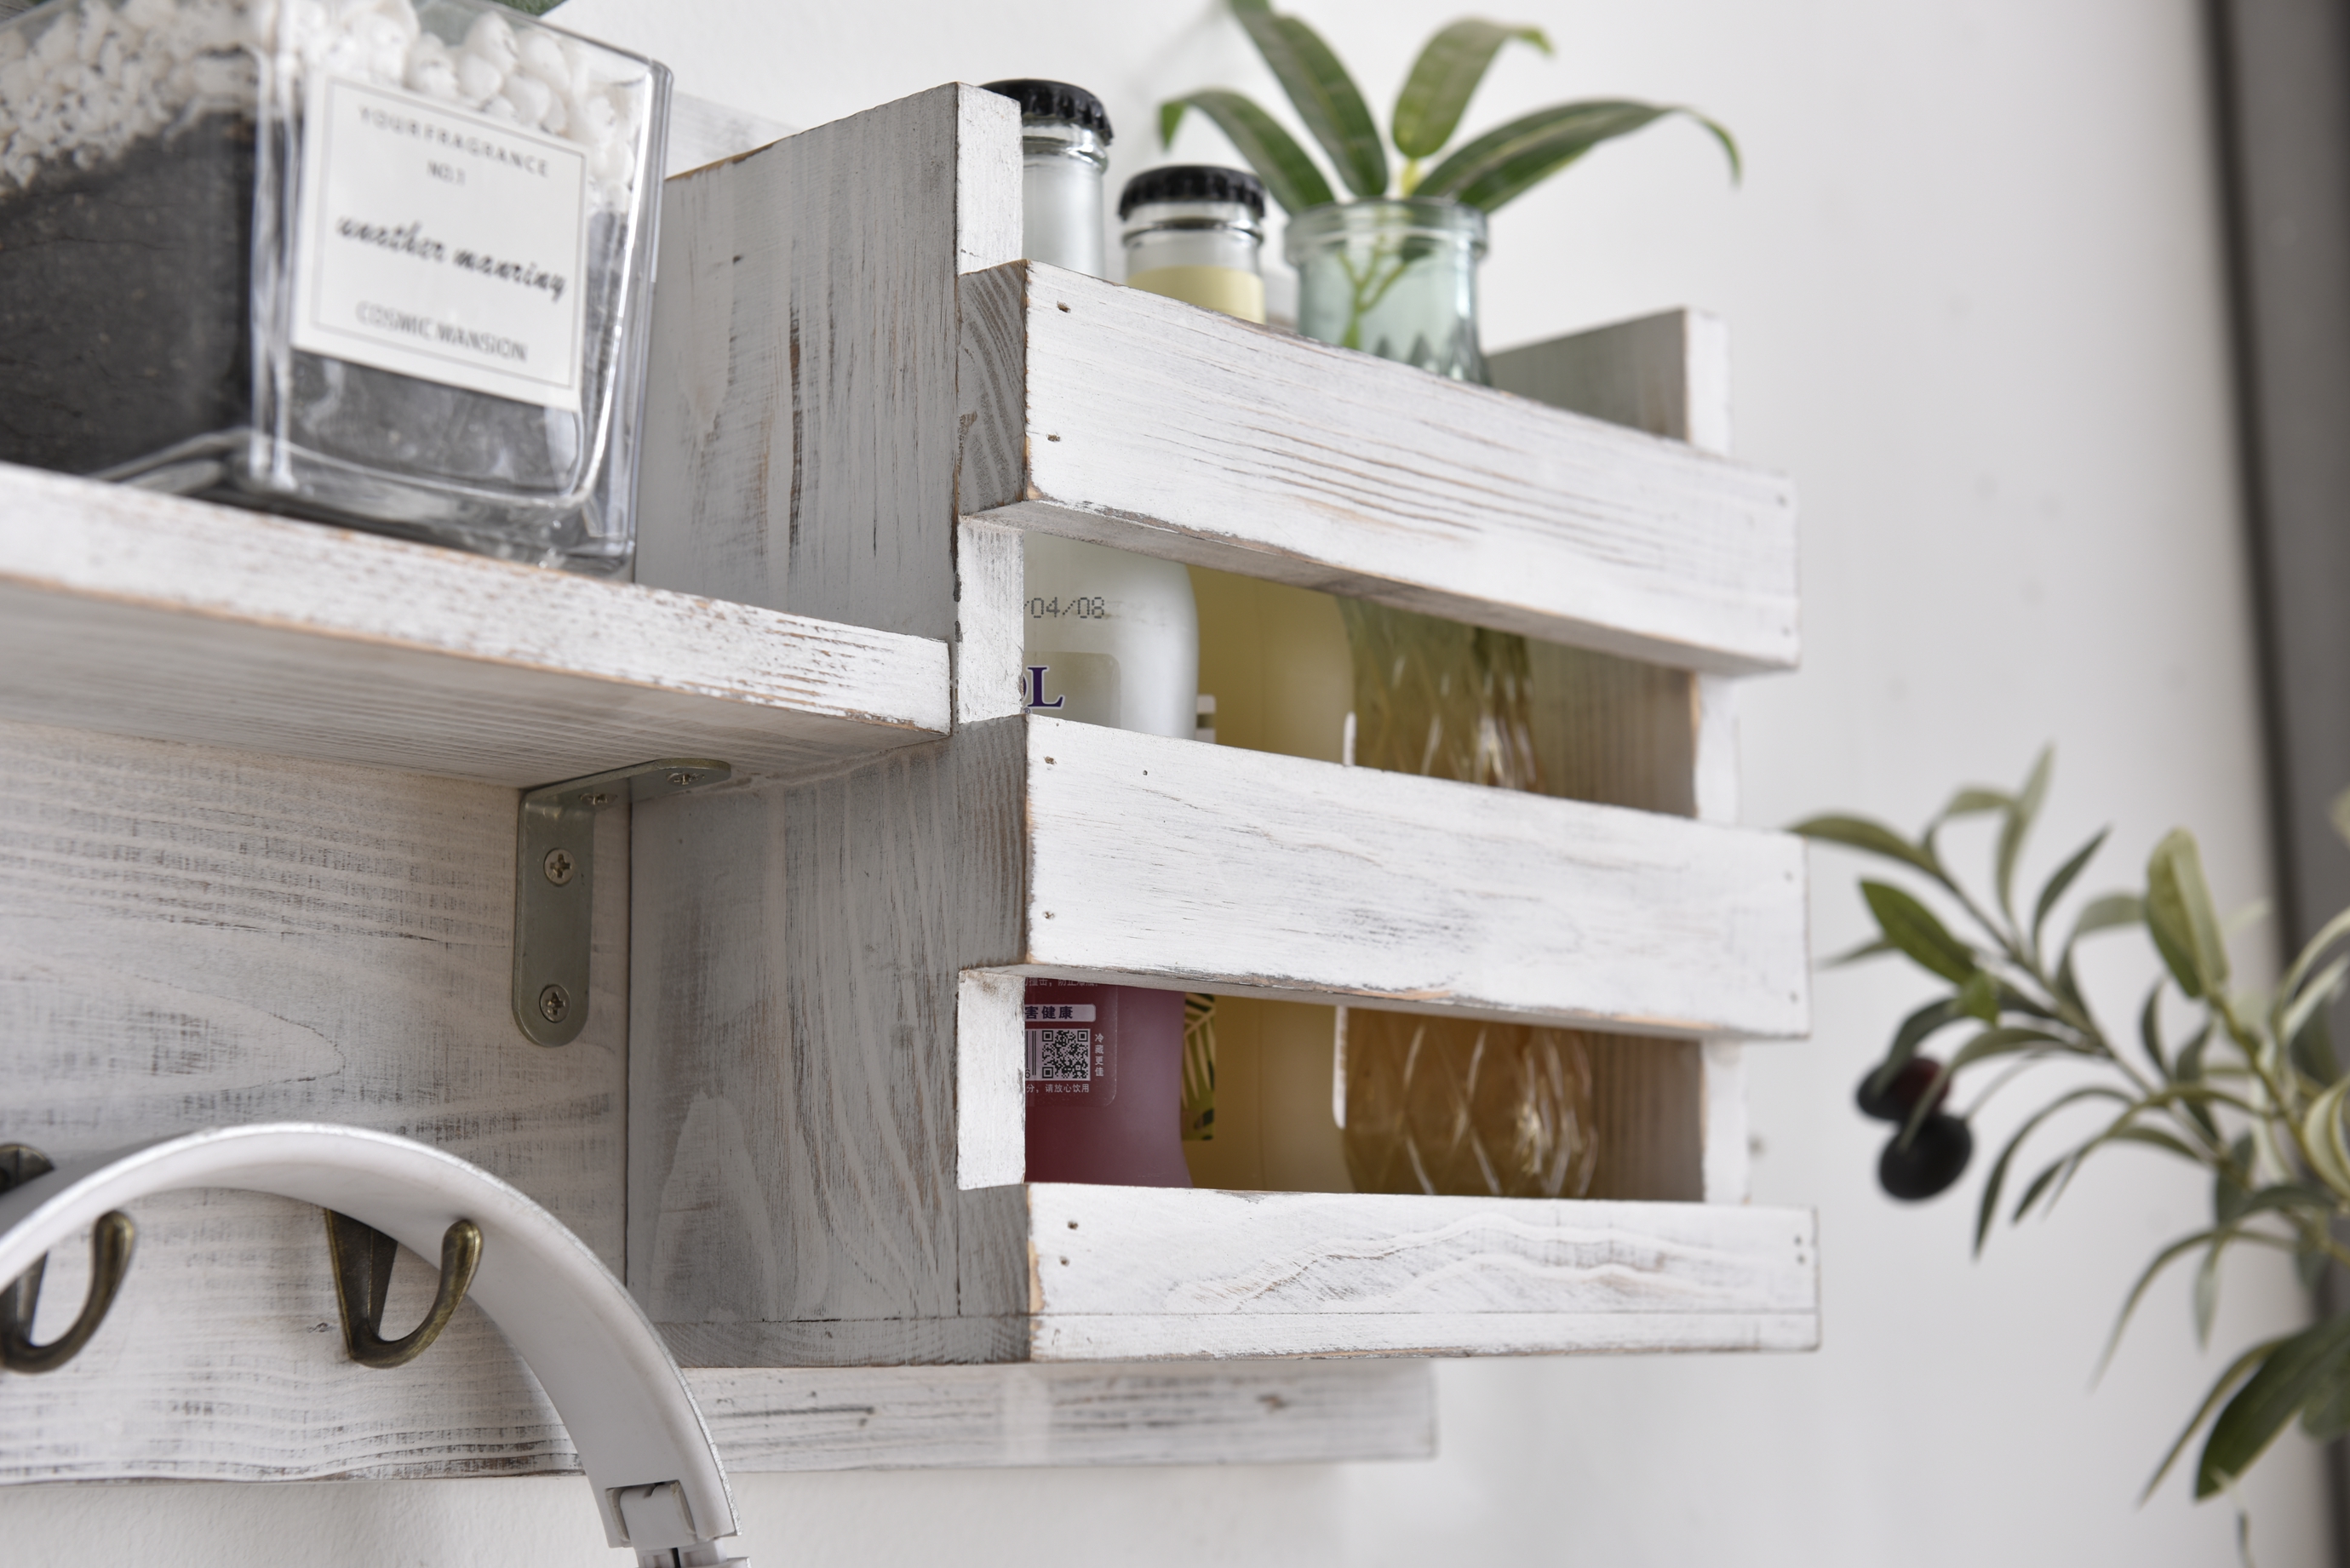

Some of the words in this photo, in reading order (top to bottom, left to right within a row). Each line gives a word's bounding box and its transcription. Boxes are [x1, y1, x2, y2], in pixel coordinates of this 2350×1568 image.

[1023, 667, 1063, 708] L
[1025, 1006, 1073, 1020] 害健康
[1094, 1033, 1104, 1077] 冷藏更佳
[1026, 1084, 1089, 1093] 分，请放心饮用
